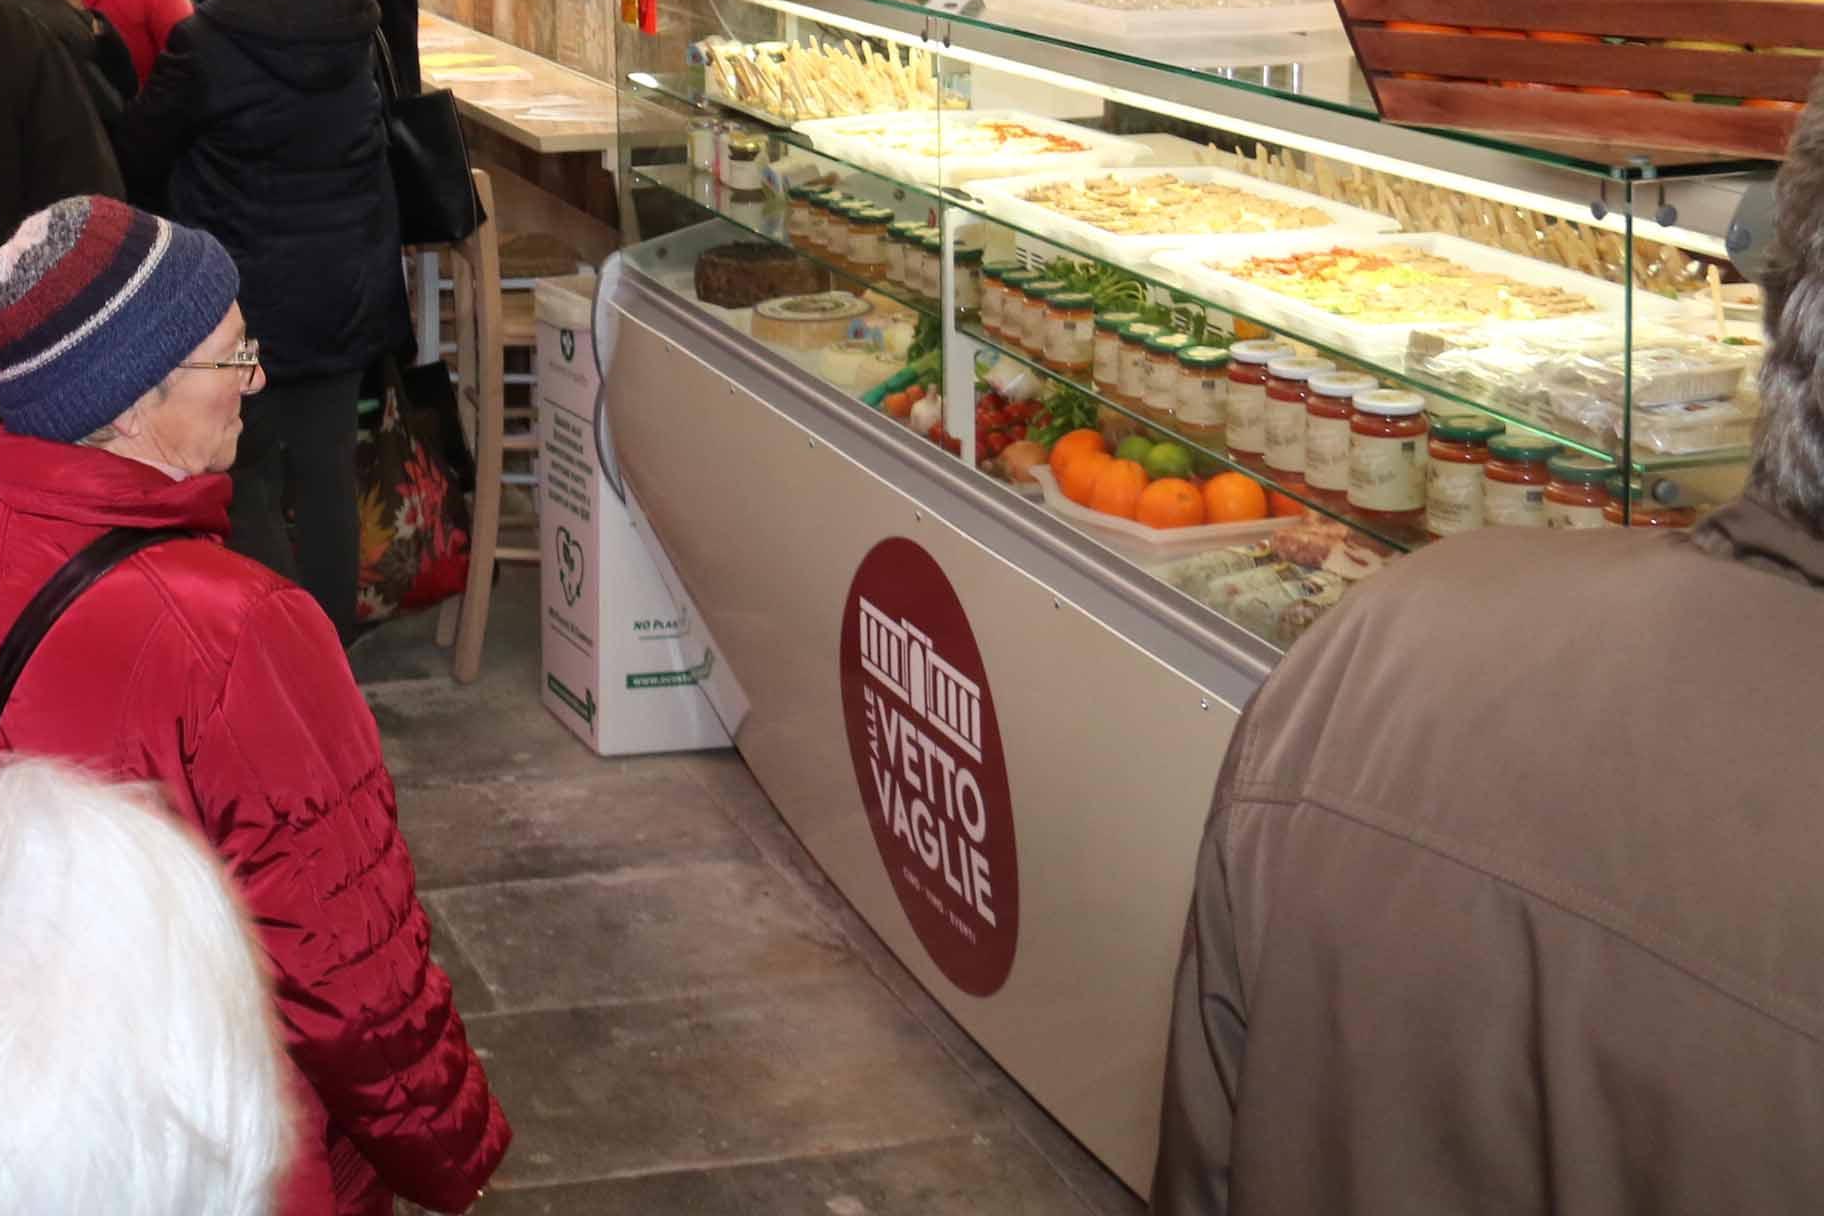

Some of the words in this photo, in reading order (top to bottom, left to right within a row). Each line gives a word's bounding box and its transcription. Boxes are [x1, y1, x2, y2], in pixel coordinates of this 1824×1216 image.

[862, 684, 879, 761] ALLE
[875, 695, 987, 844] VETTO
[870, 756, 997, 929] VAGLIE
